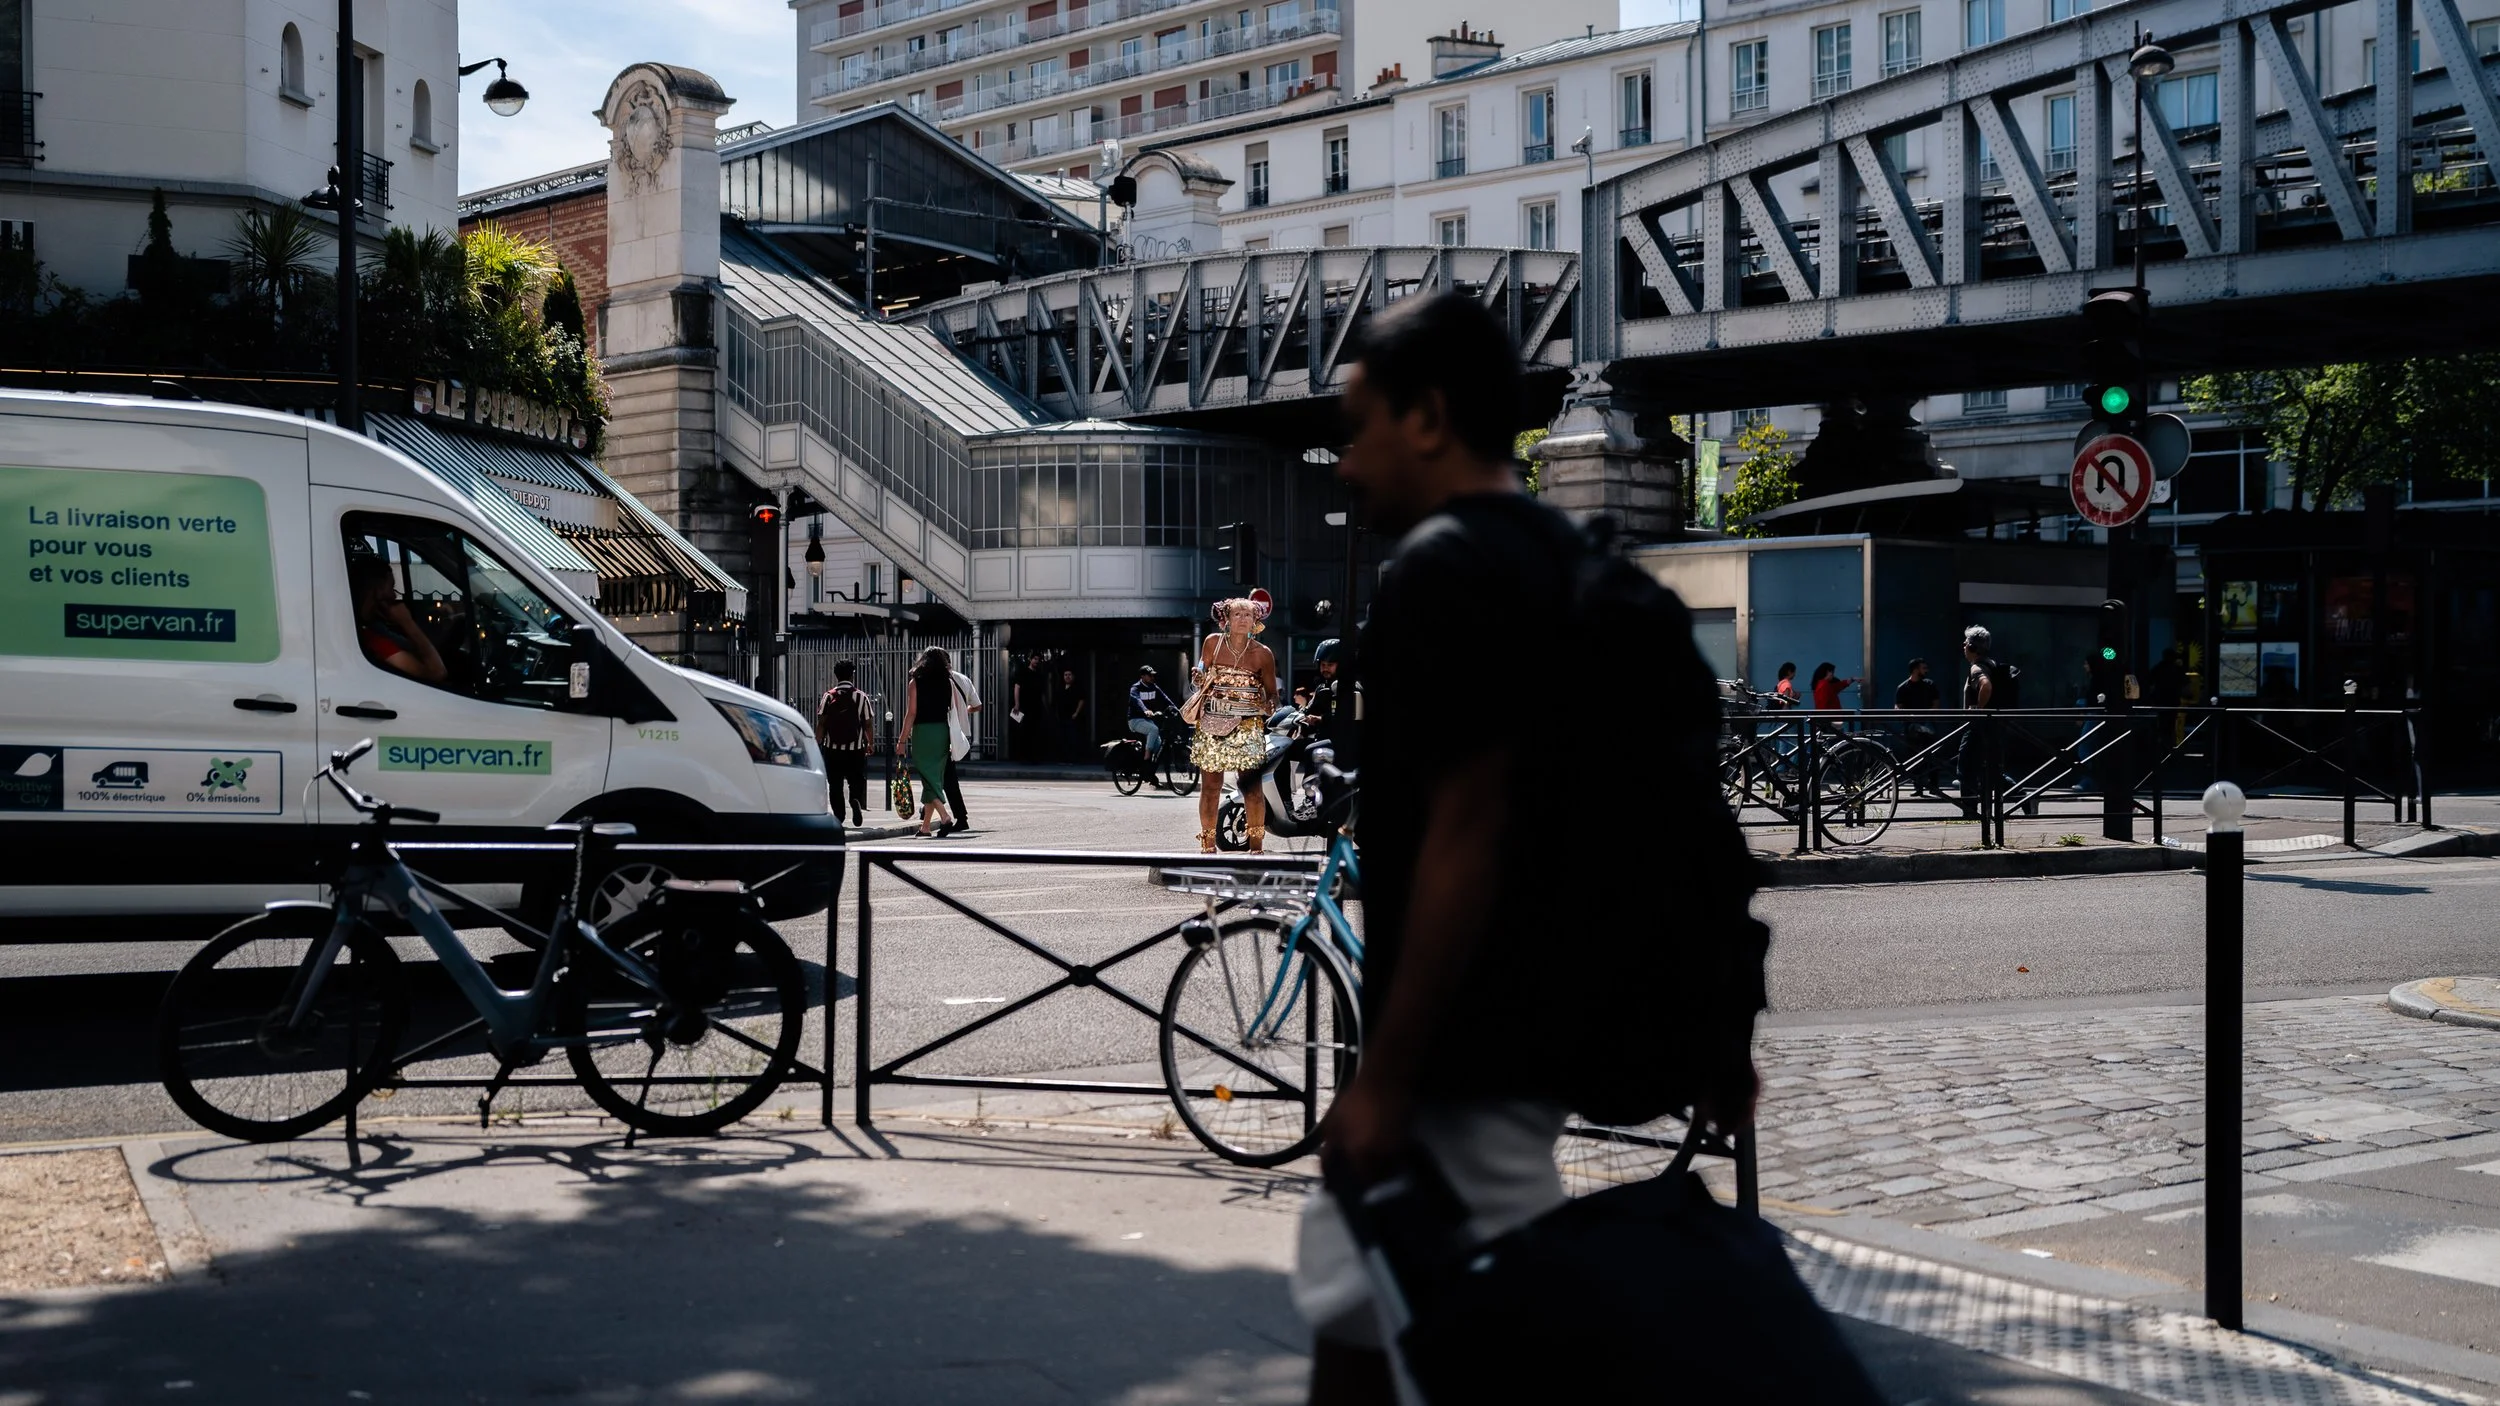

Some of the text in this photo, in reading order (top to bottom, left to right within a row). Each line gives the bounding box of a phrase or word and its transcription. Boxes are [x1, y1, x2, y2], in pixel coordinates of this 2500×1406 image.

[435, 380, 571, 443] LE PIERROT
[29, 506, 237, 533] La livraison verte
[29, 539, 152, 558] pour vous
[29, 565, 190, 588] et vos clients
[76, 612, 224, 635] supervan.fr
[637, 728, 679, 742] V1215
[388, 743, 544, 770] supervan.fr
[20, 793, 50, 808] City
[78, 791, 166, 803] 100% électrique
[186, 792, 260, 804] 0% émissions
